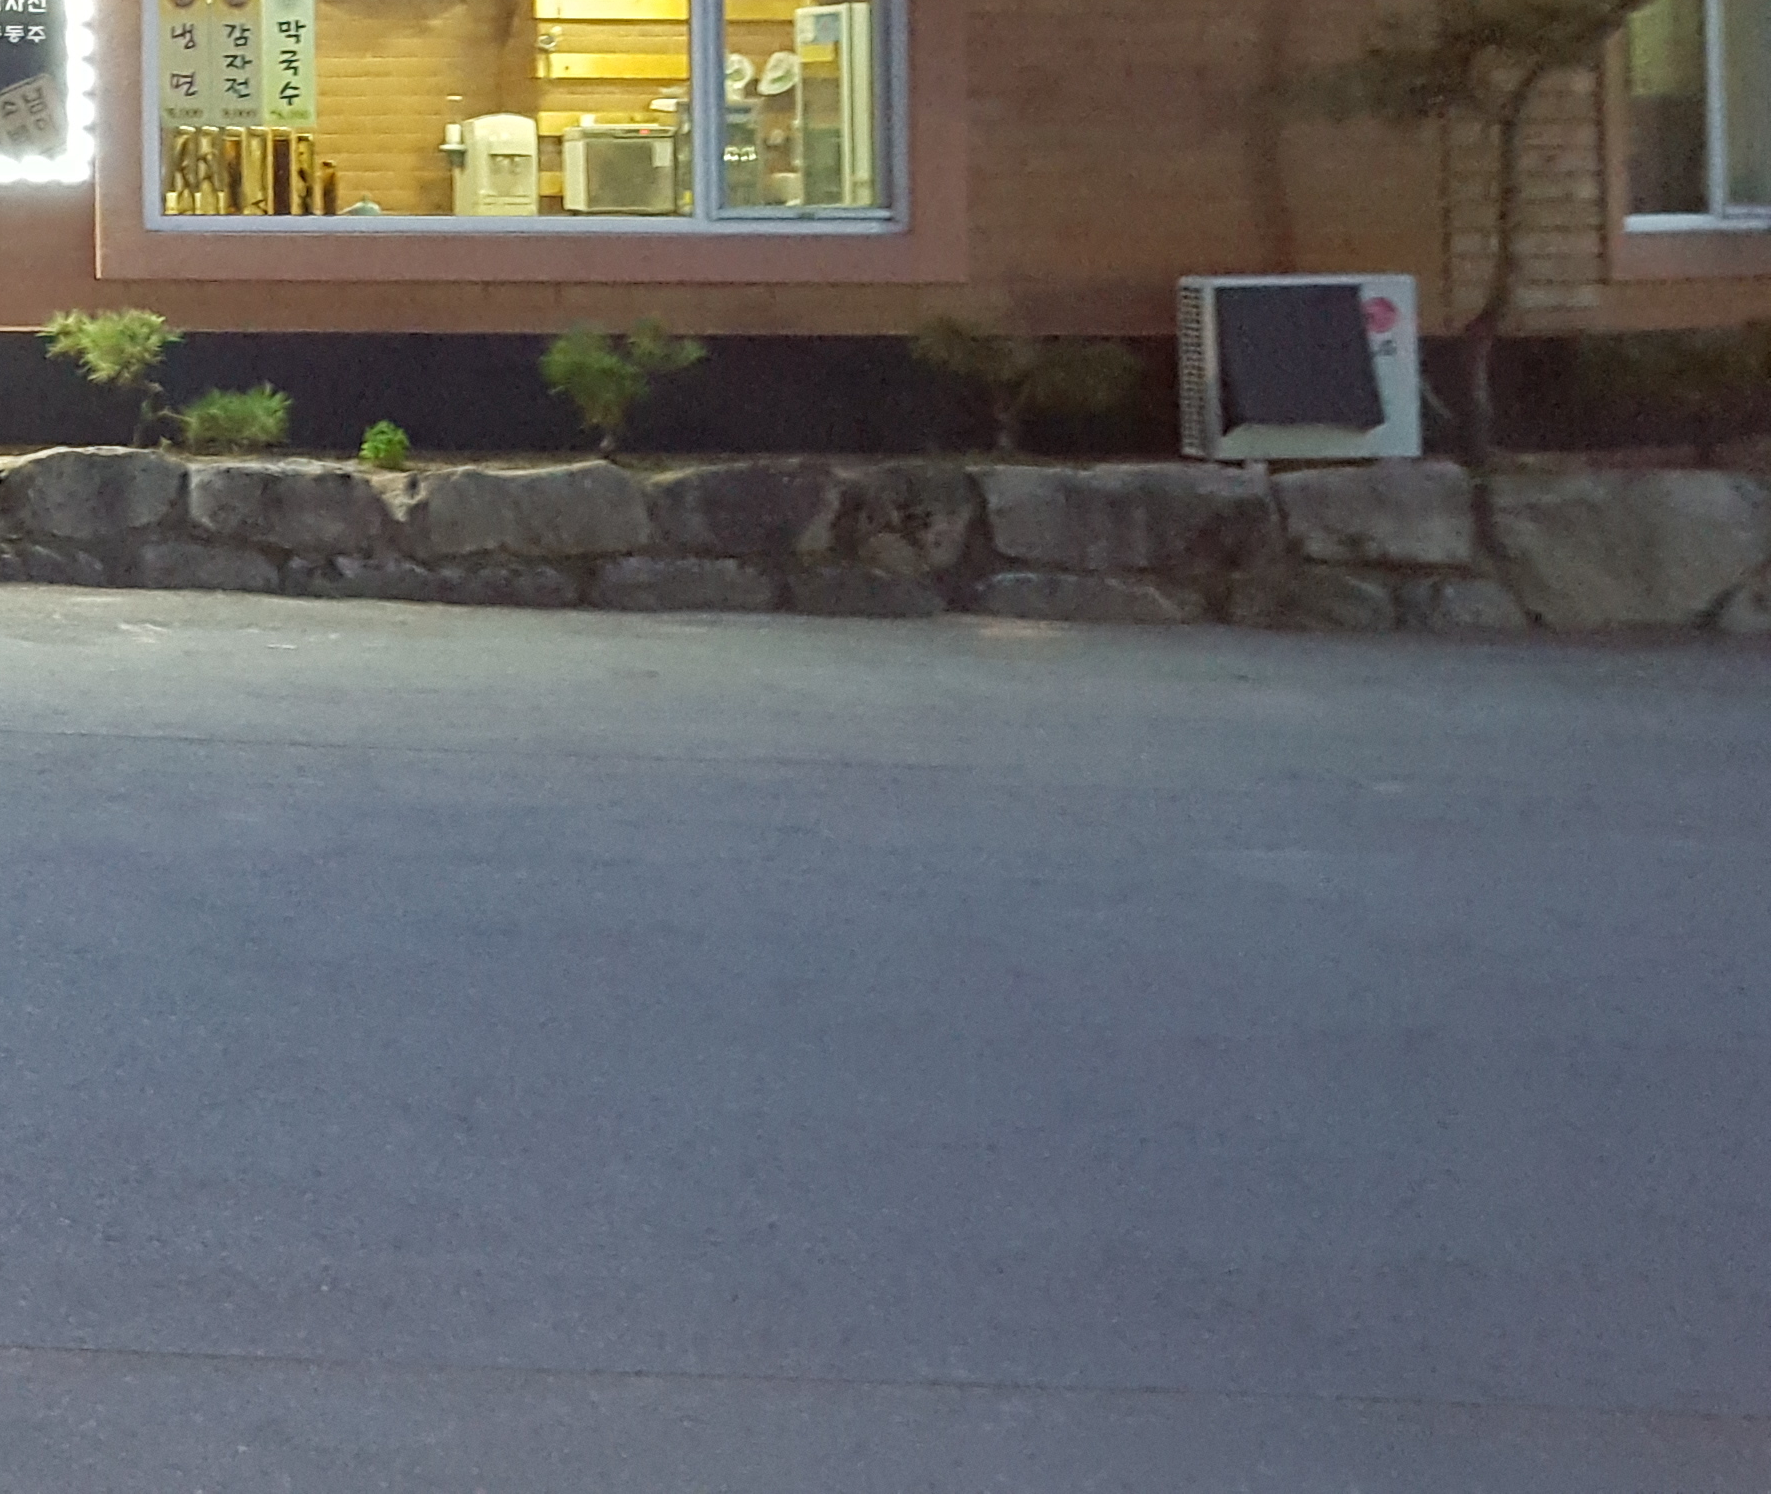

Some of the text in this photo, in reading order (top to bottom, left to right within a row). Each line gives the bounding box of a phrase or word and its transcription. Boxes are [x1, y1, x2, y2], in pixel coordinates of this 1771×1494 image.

[170, 22, 199, 97] 냉면
[222, 22, 253, 99] 감자전
[276, 19, 307, 107] 막국수
